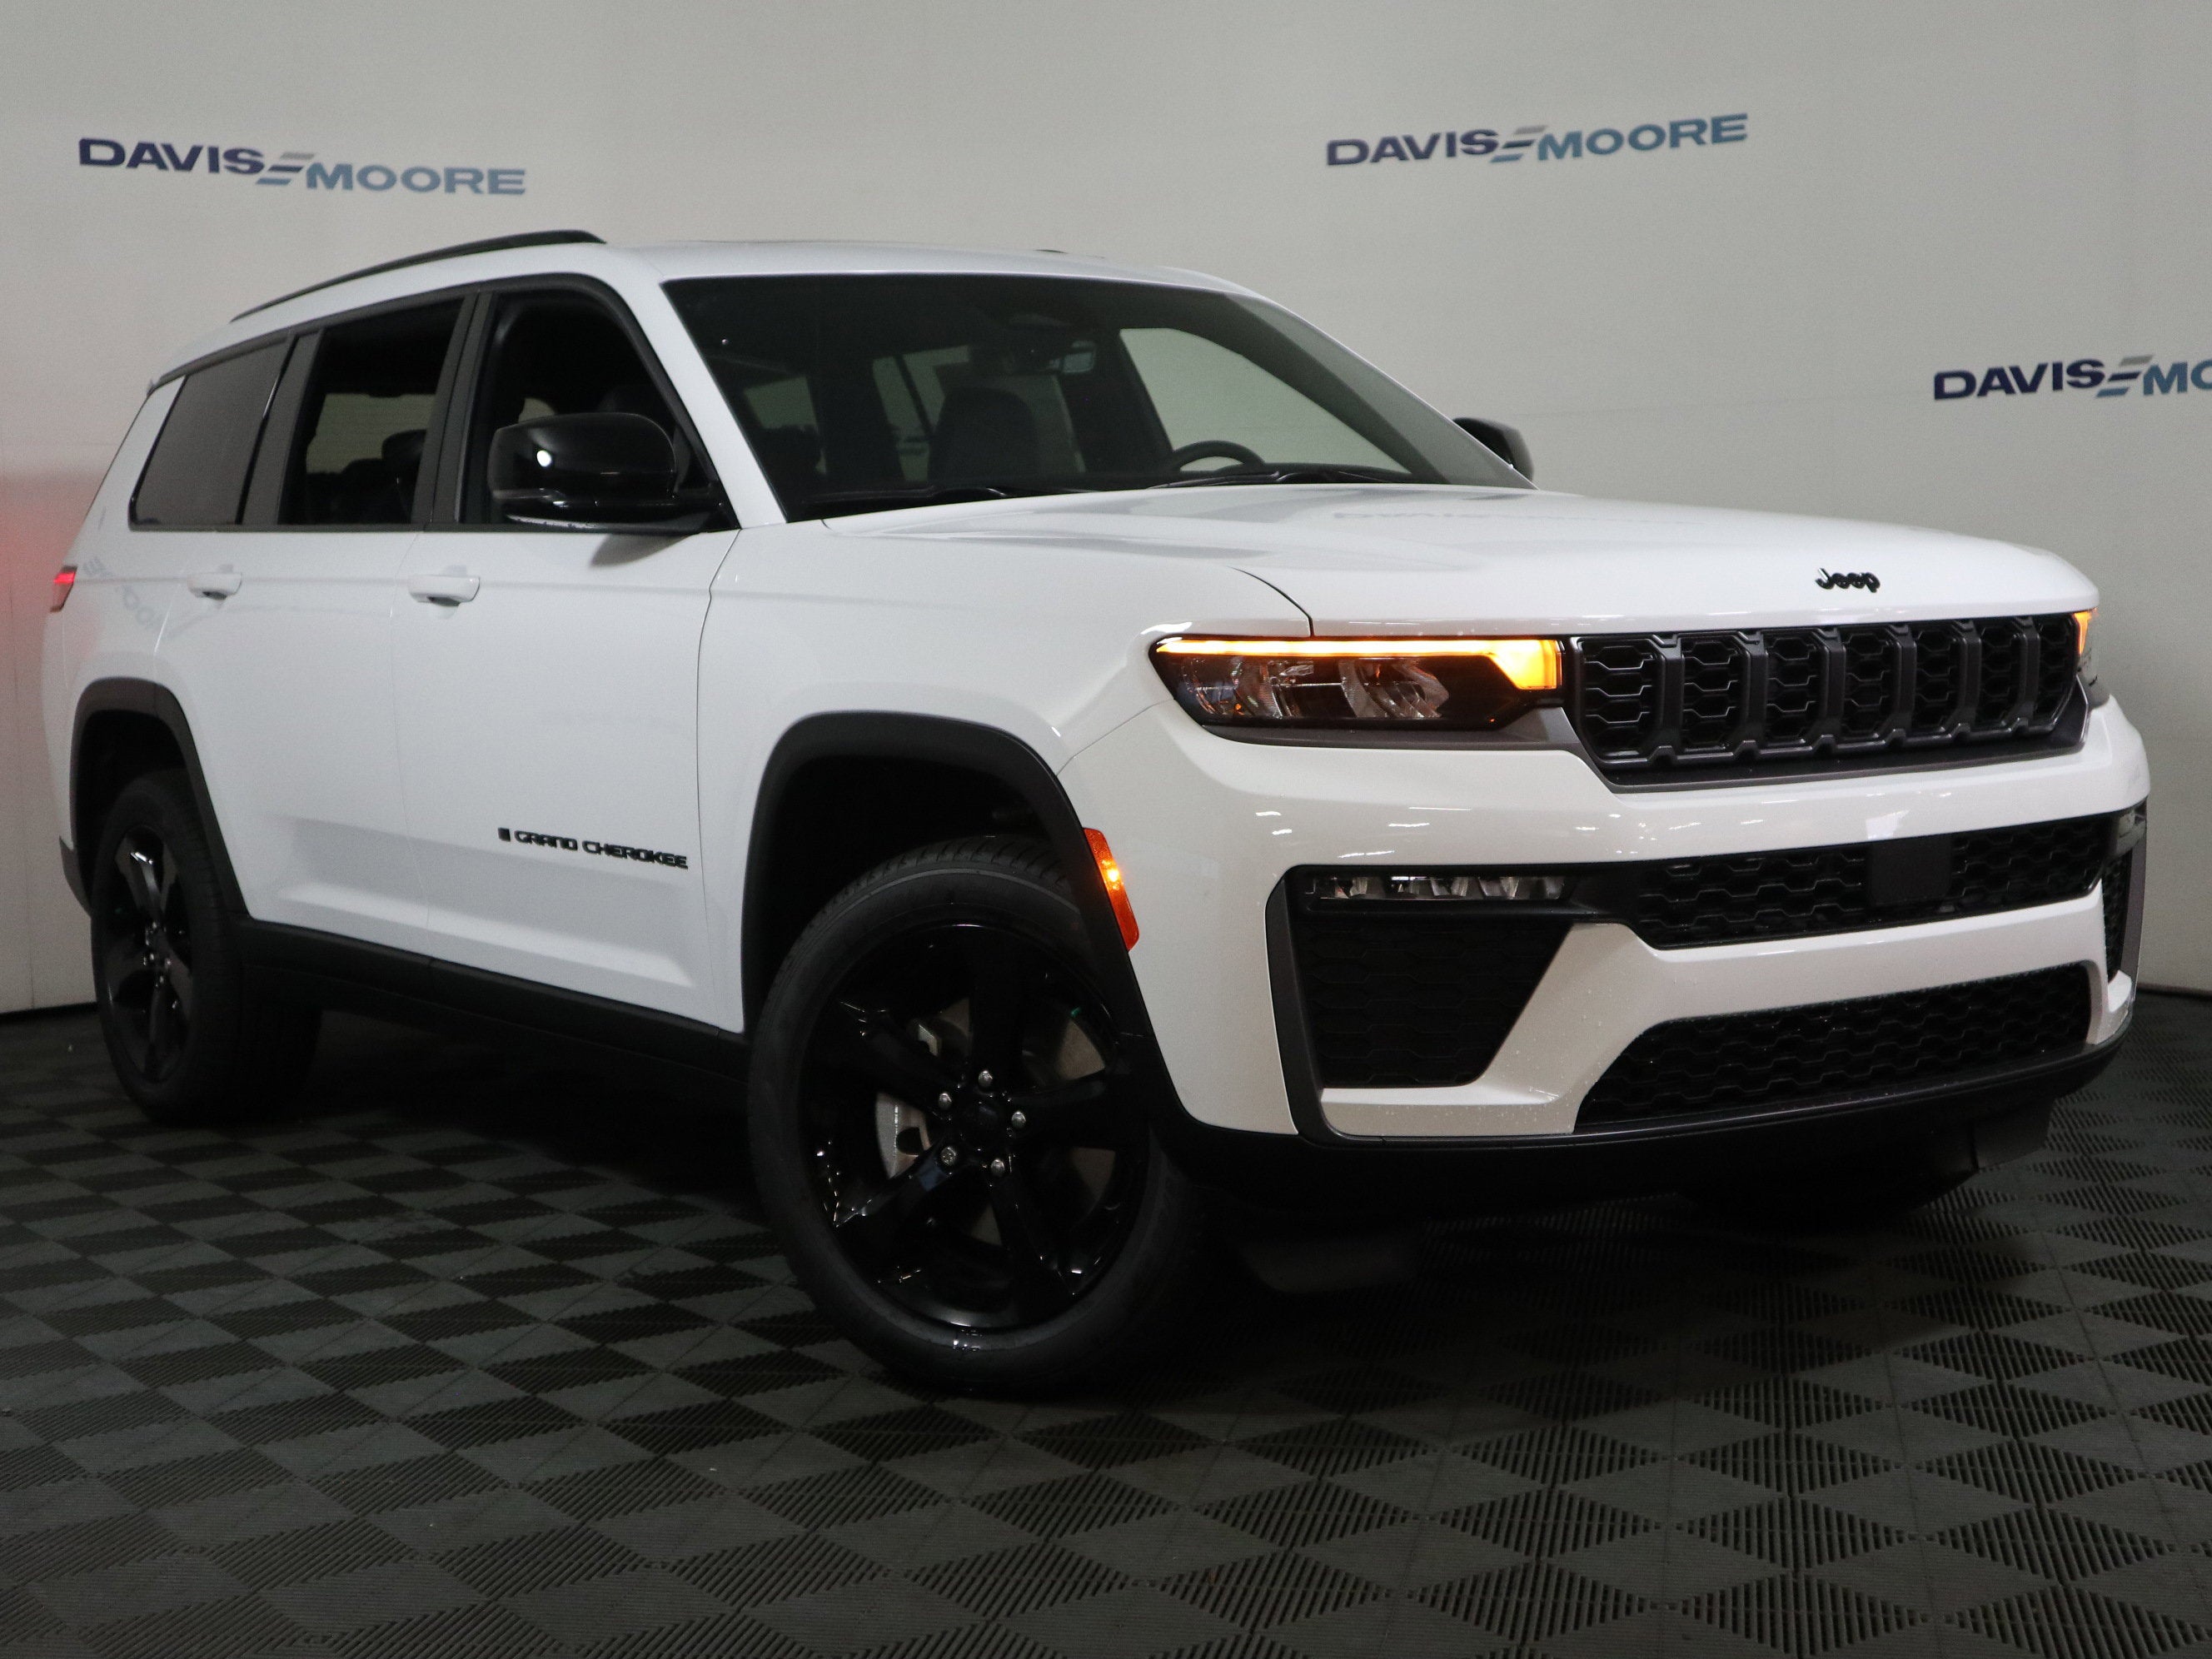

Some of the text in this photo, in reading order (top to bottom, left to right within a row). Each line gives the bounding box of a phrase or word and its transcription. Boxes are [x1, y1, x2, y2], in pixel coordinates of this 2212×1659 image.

[1327, 113, 1748, 167] DAVIS MOORE
[78, 137, 526, 196] DAVIS MOORE
[1933, 359, 2106, 401] DAVIS
[1815, 567, 1881, 594] Jeep
[514, 830, 689, 869] GRAND CHEROKEE
